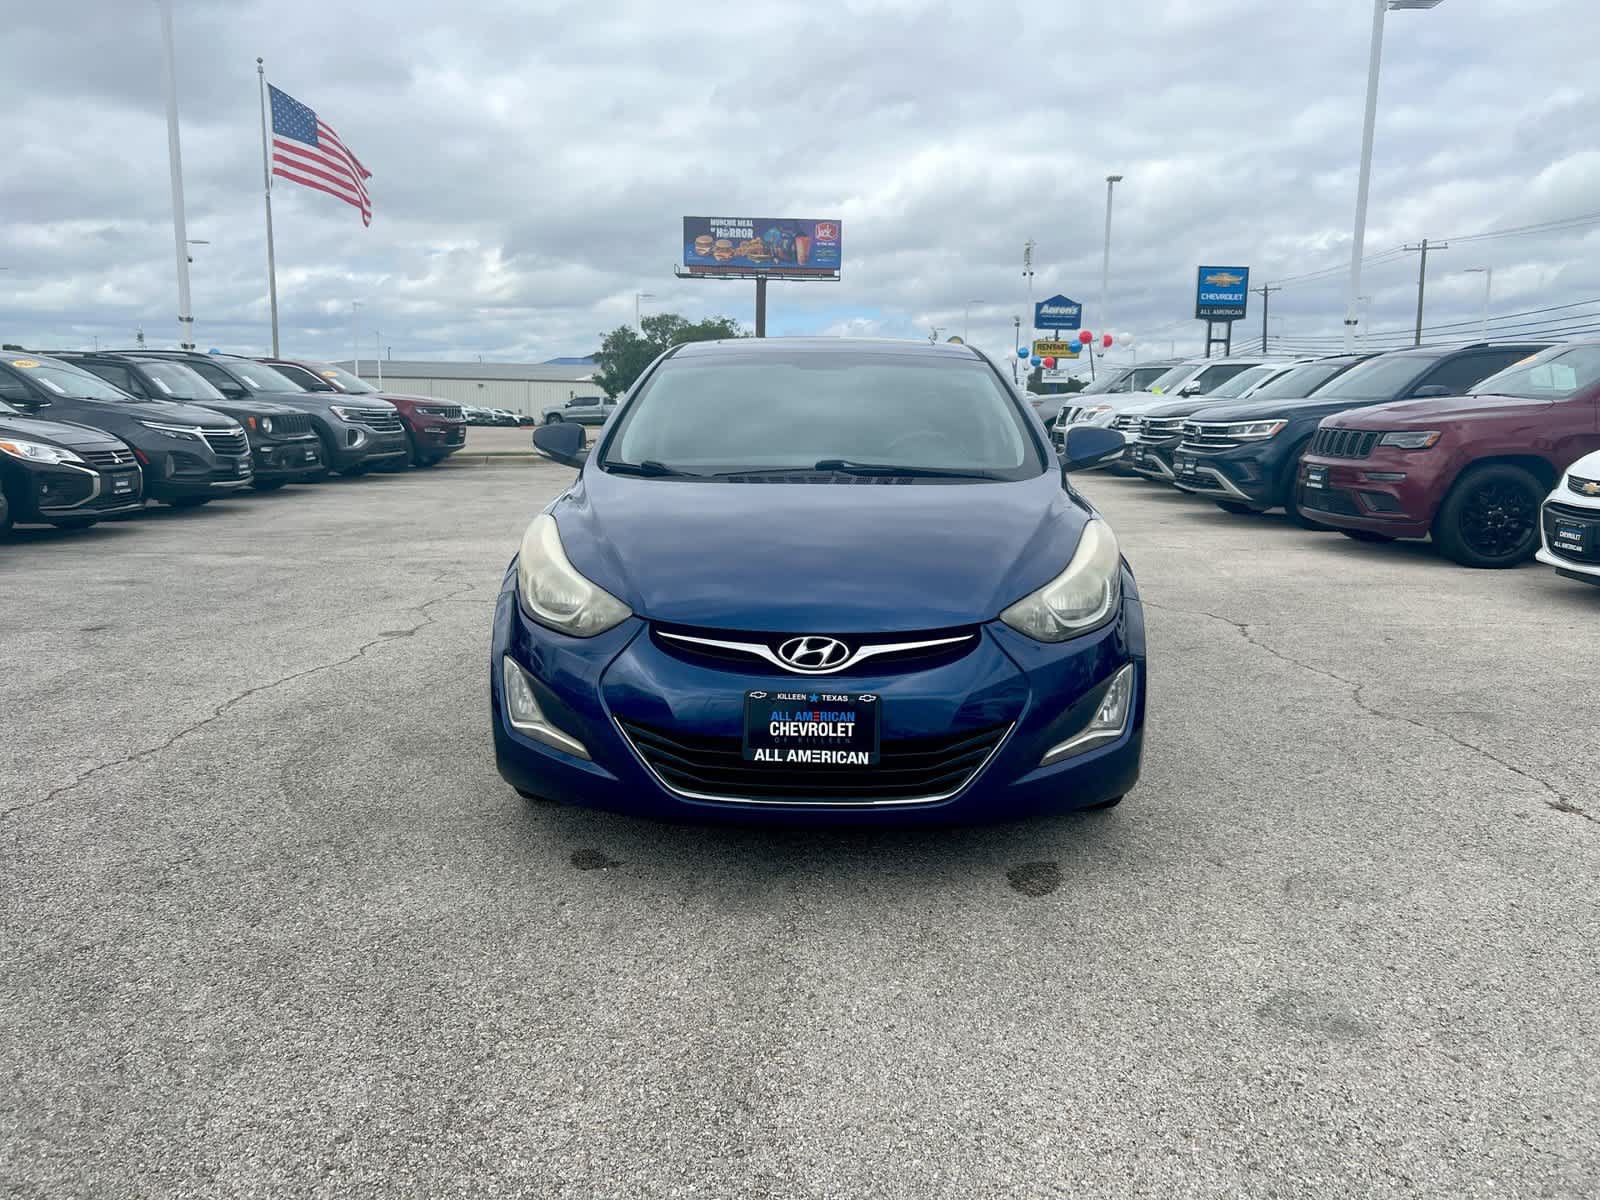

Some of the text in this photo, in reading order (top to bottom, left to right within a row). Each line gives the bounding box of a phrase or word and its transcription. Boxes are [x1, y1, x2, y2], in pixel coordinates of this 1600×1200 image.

[1200, 293, 1243, 301] CHEVROLET
[1040, 304, 1079, 315] Aaron's
[1212, 308, 1243, 316] AMERICAN
[777, 693, 849, 702] KILLEEN TEXAS
[770, 711, 855, 722] ALL AMERICAN
[769, 721, 855, 737] CHEVROLET
[754, 748, 869, 765] ALL AMERICAN
